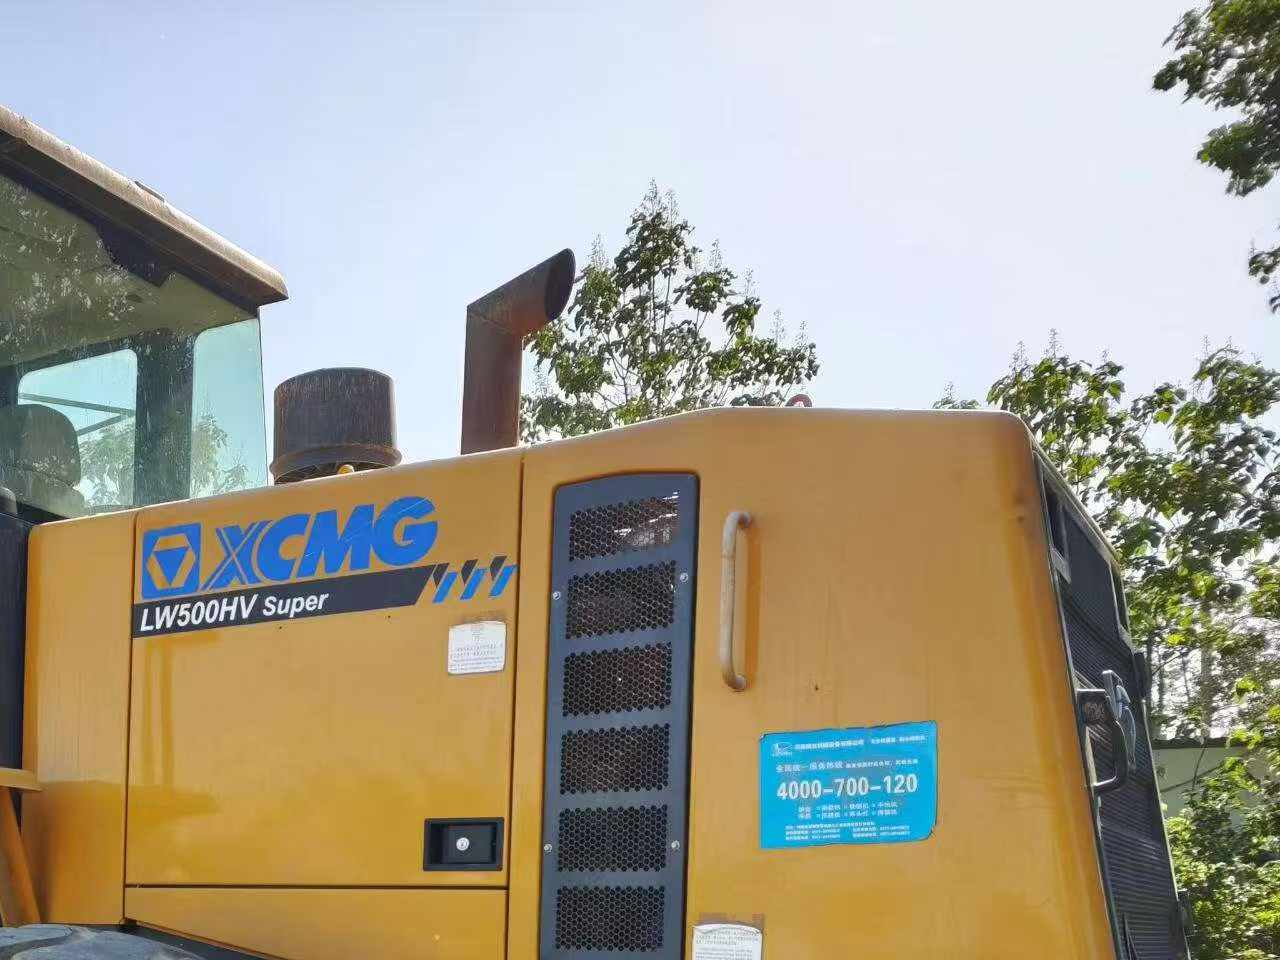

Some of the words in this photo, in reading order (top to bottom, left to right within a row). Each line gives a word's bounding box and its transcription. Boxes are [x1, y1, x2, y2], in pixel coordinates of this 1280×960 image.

[200, 496, 438, 591] XCMG
[140, 594, 257, 633] LW500HV
[263, 592, 329, 619] Super
[776, 773, 918, 800] 4000-700-120
